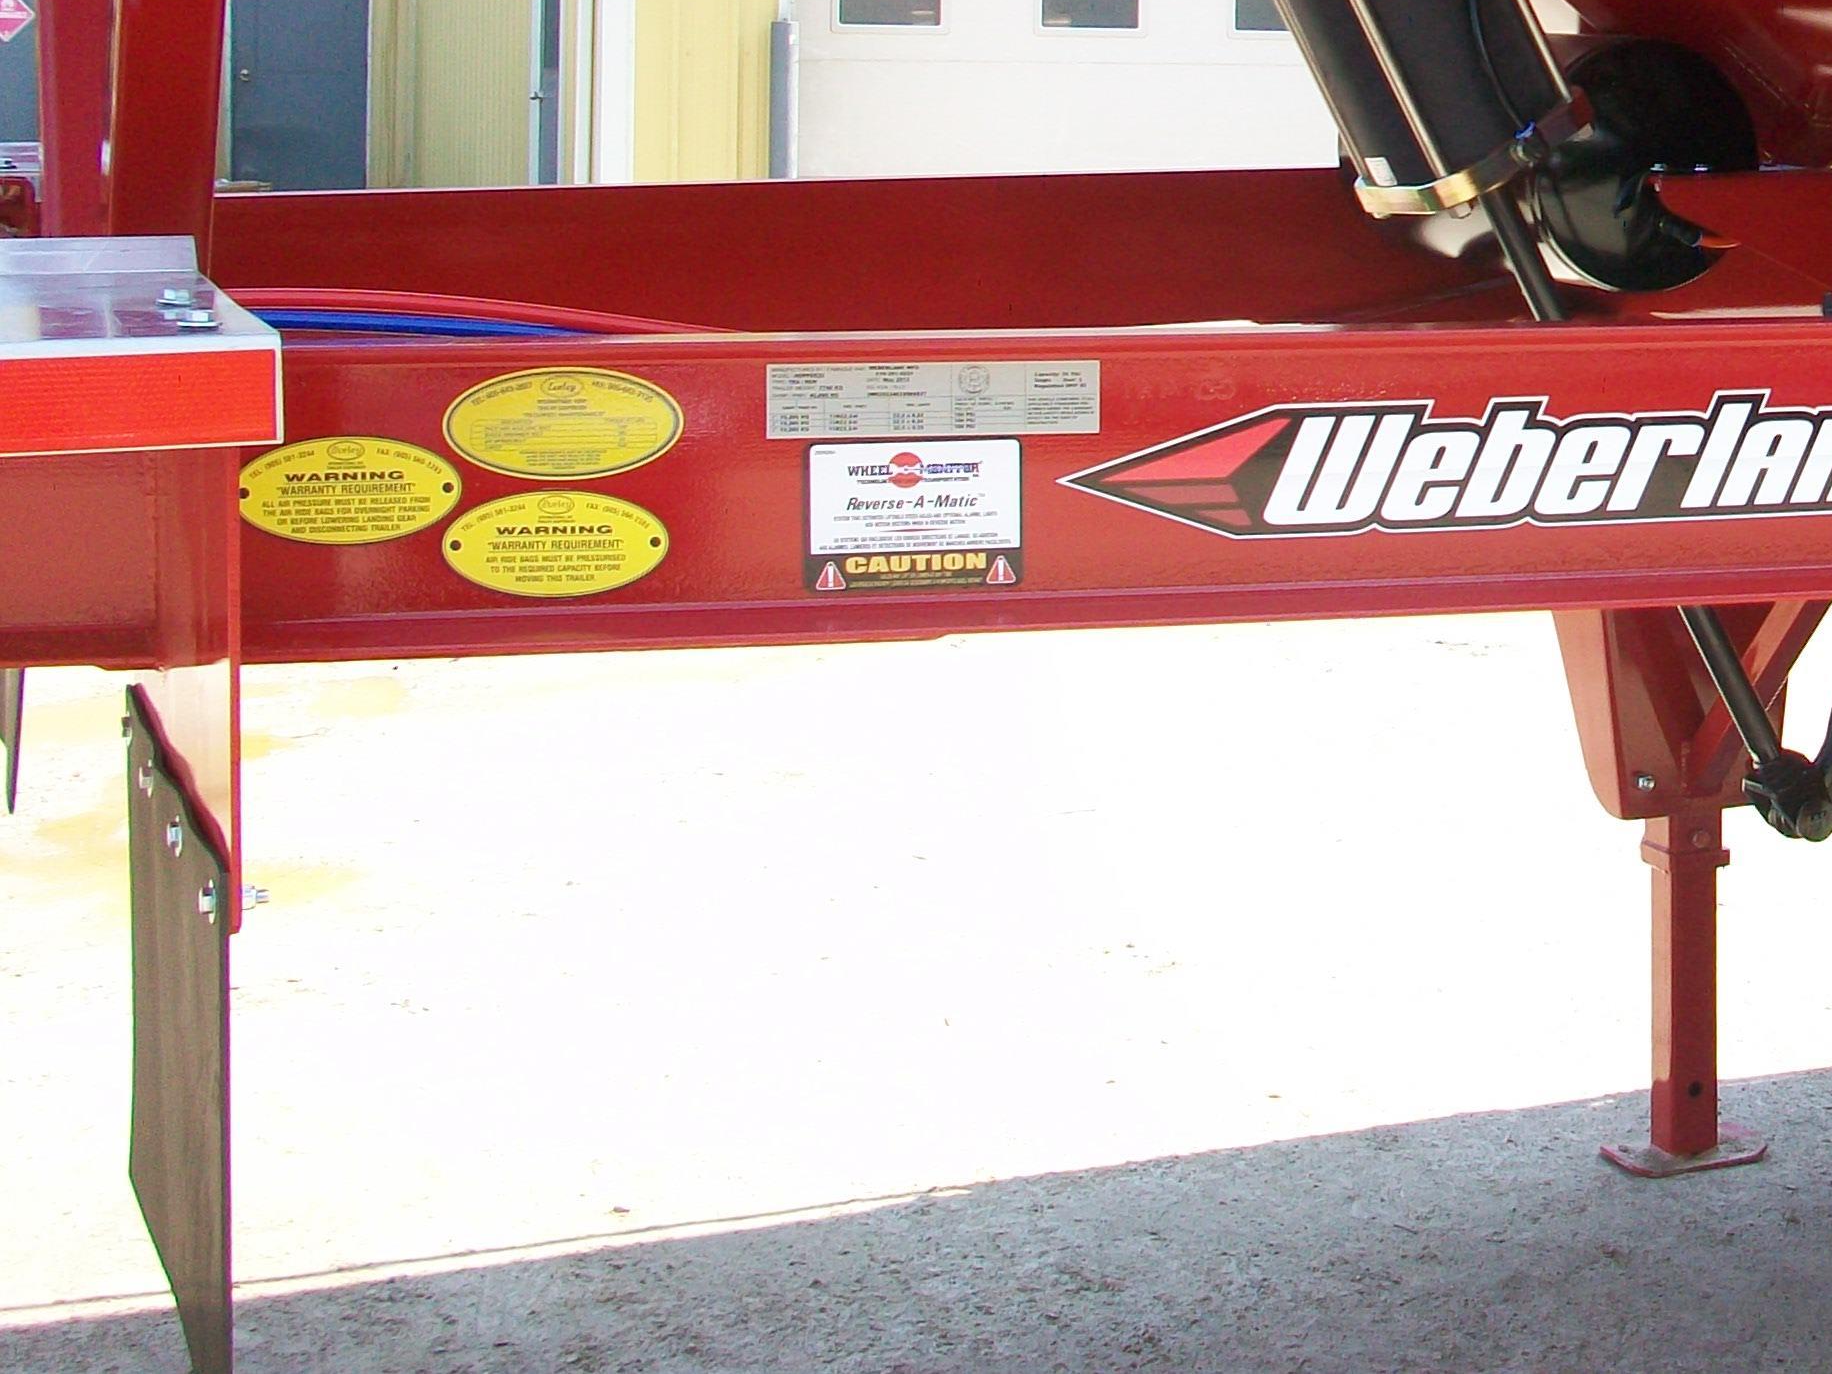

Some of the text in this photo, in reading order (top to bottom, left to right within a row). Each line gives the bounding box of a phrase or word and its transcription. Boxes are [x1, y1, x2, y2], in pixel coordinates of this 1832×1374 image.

[284, 470, 405, 483] WARNING
[847, 464, 893, 477] WHEEL
[495, 524, 613, 535] WARNING
[845, 552, 988, 574] CAUTION
